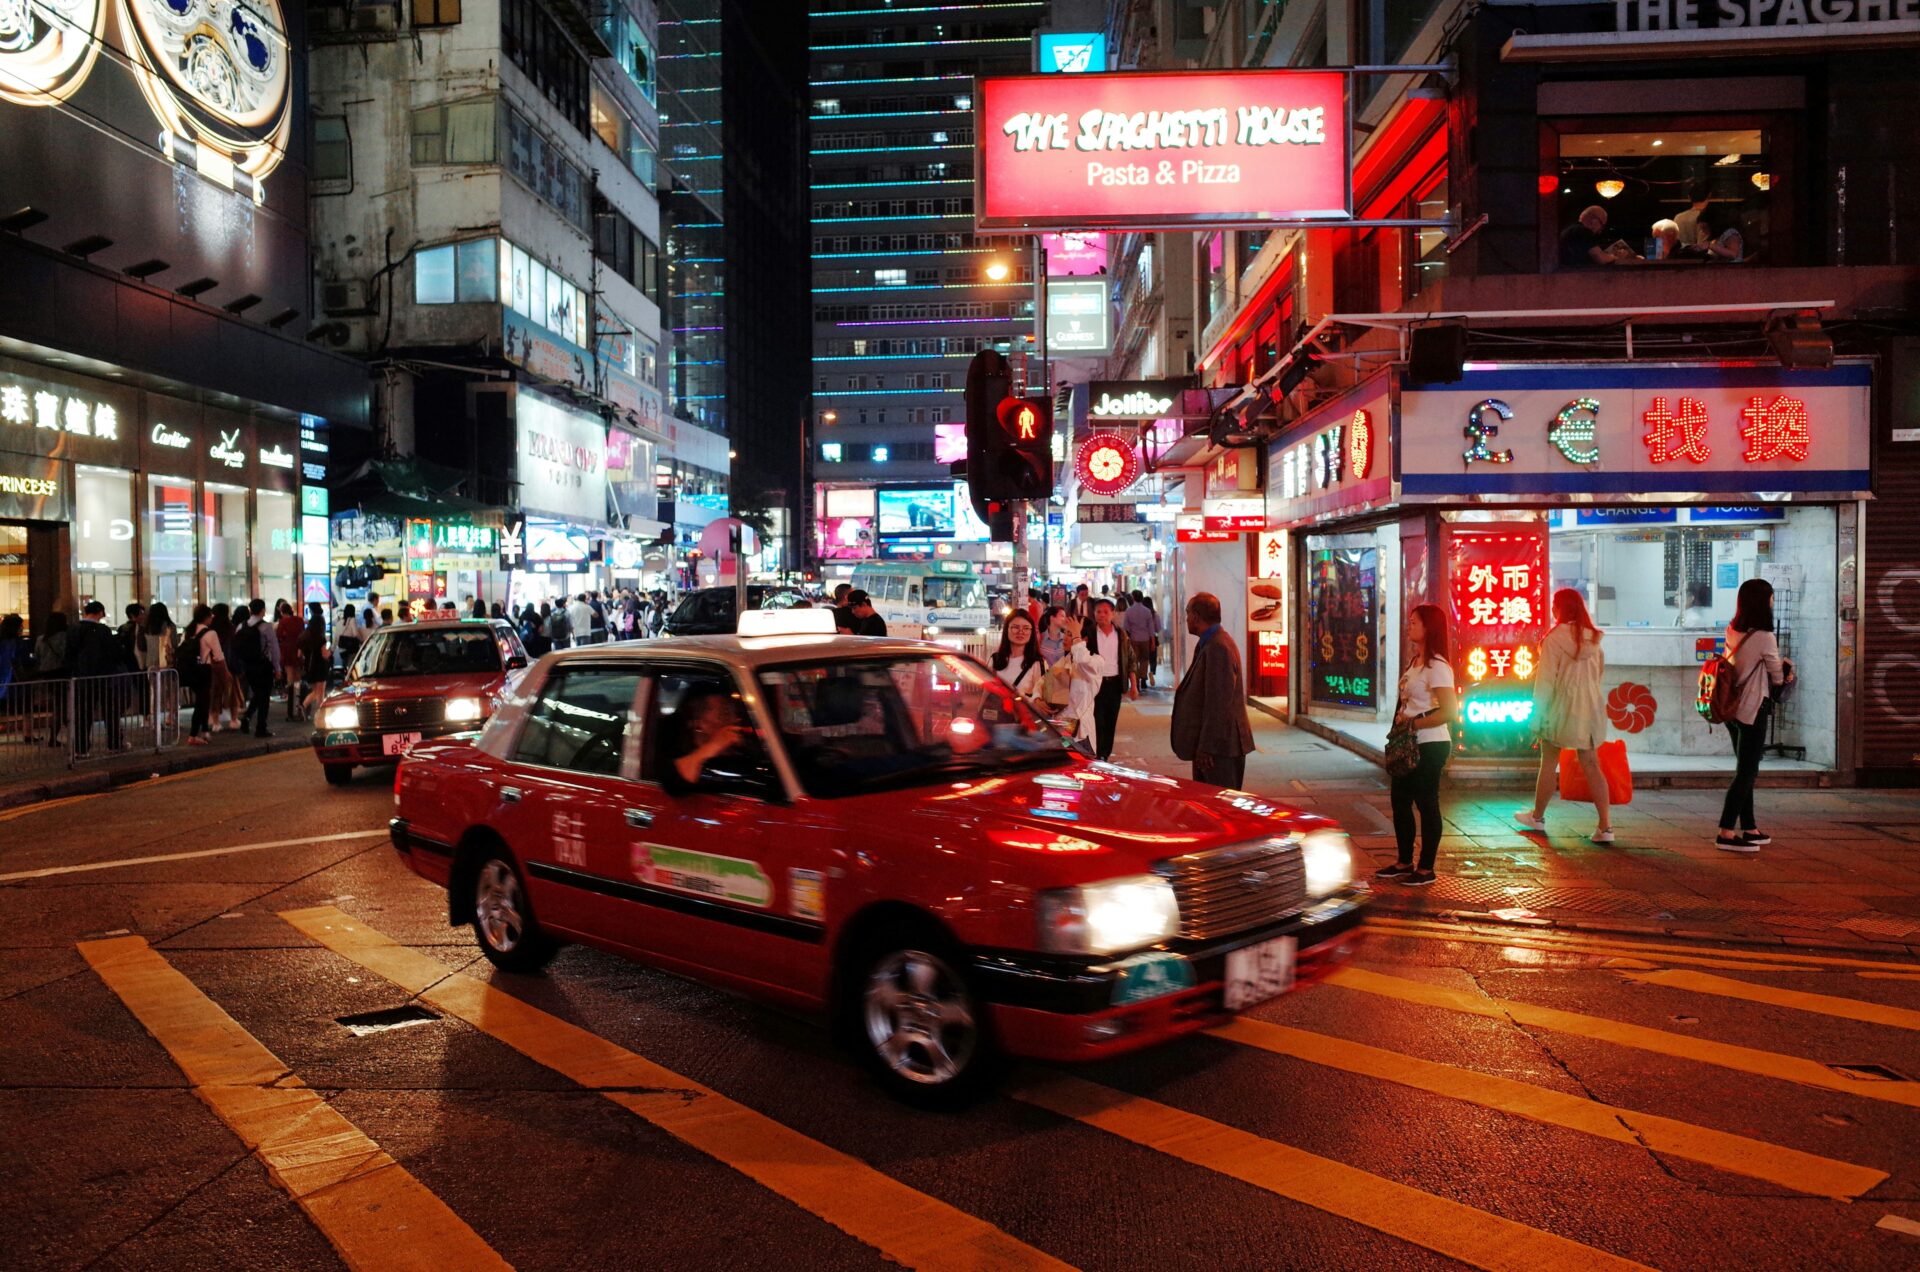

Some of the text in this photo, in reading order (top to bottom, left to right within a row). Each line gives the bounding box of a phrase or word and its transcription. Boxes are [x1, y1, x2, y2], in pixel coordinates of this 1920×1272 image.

[1614, 0, 1699, 32] THE
[1003, 112, 1069, 151] THE
[1235, 105, 1326, 146] HOUSE
[1087, 160, 1240, 186] Pasta & Pizza
[1056, 331, 1096, 342] GUINNESS
[151, 423, 191, 448] Cartier
[1463, 397, 1601, 465] £ €
[1643, 395, 1811, 464] 找換
[500, 521, 522, 564] ¥
[1322, 630, 1335, 661] $
[1356, 631, 1369, 661] $
[1468, 645, 1533, 680] $ ¥ $
[395, 733, 410, 744] JW
